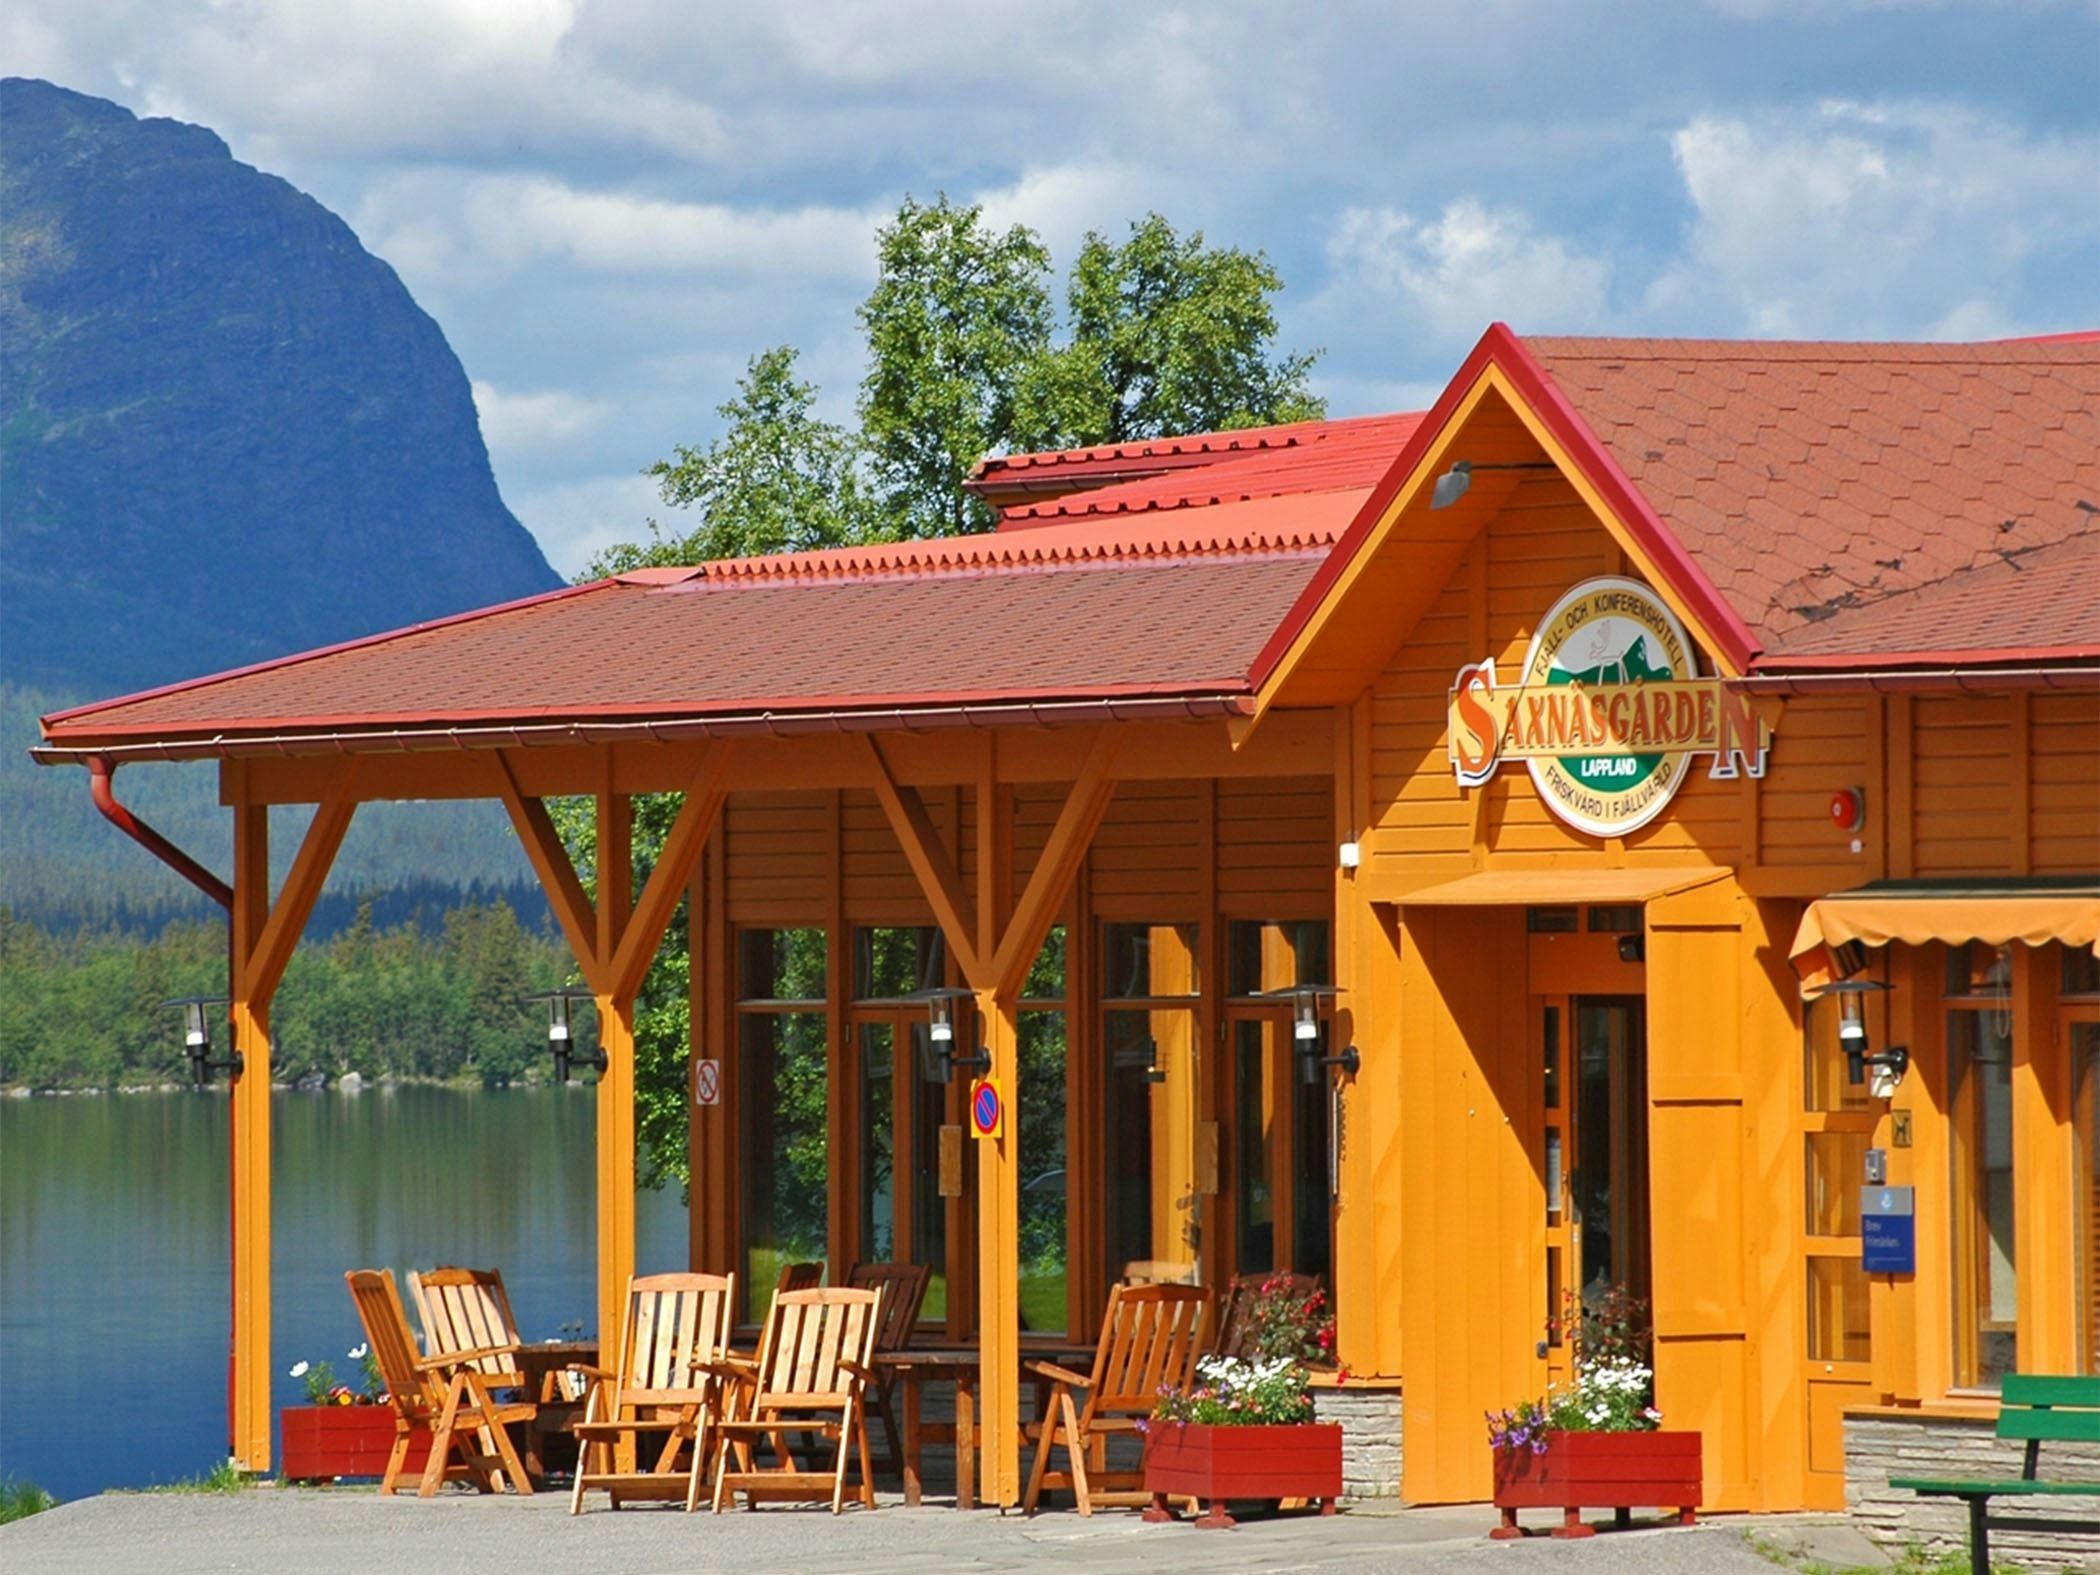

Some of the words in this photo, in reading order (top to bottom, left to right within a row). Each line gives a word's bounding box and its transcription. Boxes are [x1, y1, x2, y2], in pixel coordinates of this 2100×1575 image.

[1566, 603, 1589, 629] OCH
[1594, 593, 1683, 670] KONFERENSHOTELL
[1455, 666, 1763, 775] SAXNÄSGÅRDEN
[1545, 765, 1602, 817] FRISKVÅRD
[1605, 801, 1610, 817] I
[1581, 757, 1637, 777] LAPPLAND
